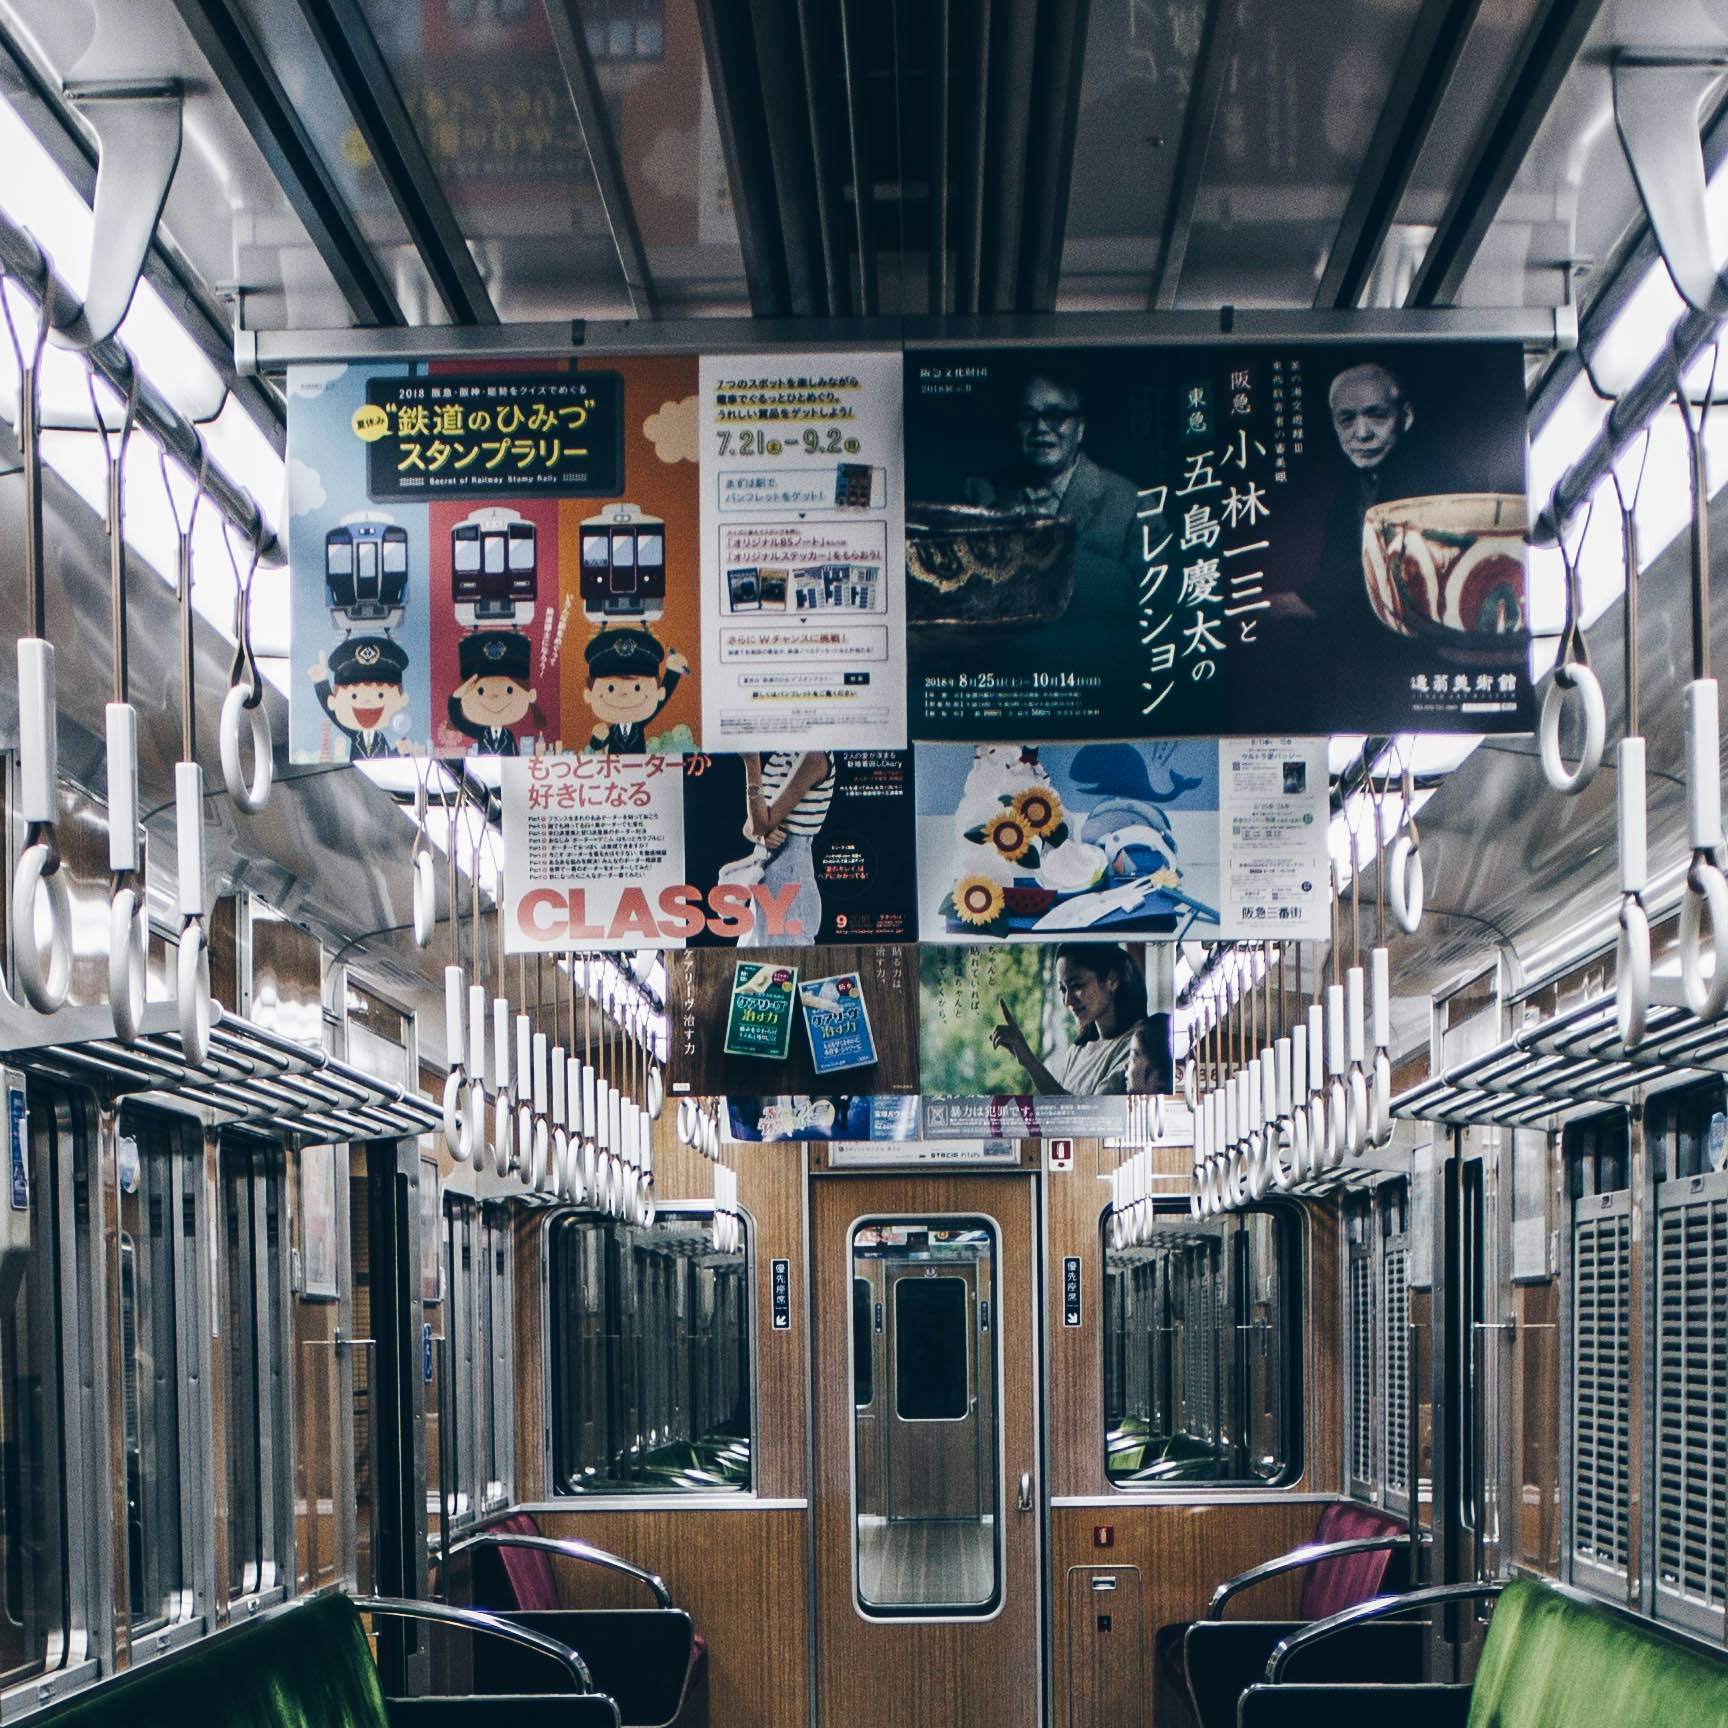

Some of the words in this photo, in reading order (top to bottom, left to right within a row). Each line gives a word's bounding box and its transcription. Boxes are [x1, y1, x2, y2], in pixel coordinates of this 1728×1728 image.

[717, 376, 859, 388] 7つのスポットを楽しみながら
[1230, 368, 1252, 415] 阪急
[399, 389, 425, 399] 2018
[716, 392, 840, 404] 電車でぐるっとひとめぐり。
[1186, 387, 1207, 435] 東急
[356, 417, 385, 430] 夏休み
[397, 438, 588, 471] スタンプラリー
[429, 476, 457, 486] Secret
[460, 476, 469, 485] of
[471, 475, 504, 485] Railway
[507, 474, 534, 485] Stamp
[536, 474, 558, 484] Rally
[1220, 428, 1271, 643] 小林一三と
[1175, 450, 1228, 682] 五島慶太の
[1136, 485, 1176, 715] コレクション
[1410, 672, 1517, 693] 逸翁美術館
[528, 781, 651, 811] 好きになる
[517, 884, 803, 941] CLASSY.
[836, 914, 848, 928] 9
[1242, 906, 1302, 920] 阪急三番街
[742, 1008, 779, 1024] 治す力
[684, 1014, 695, 1055] 治す力
[821, 1022, 857, 1039] 治す力
[950, 1105, 1034, 1118] 暴力は犯罪です。
[1067, 1261, 1078, 1302] 優先座席
